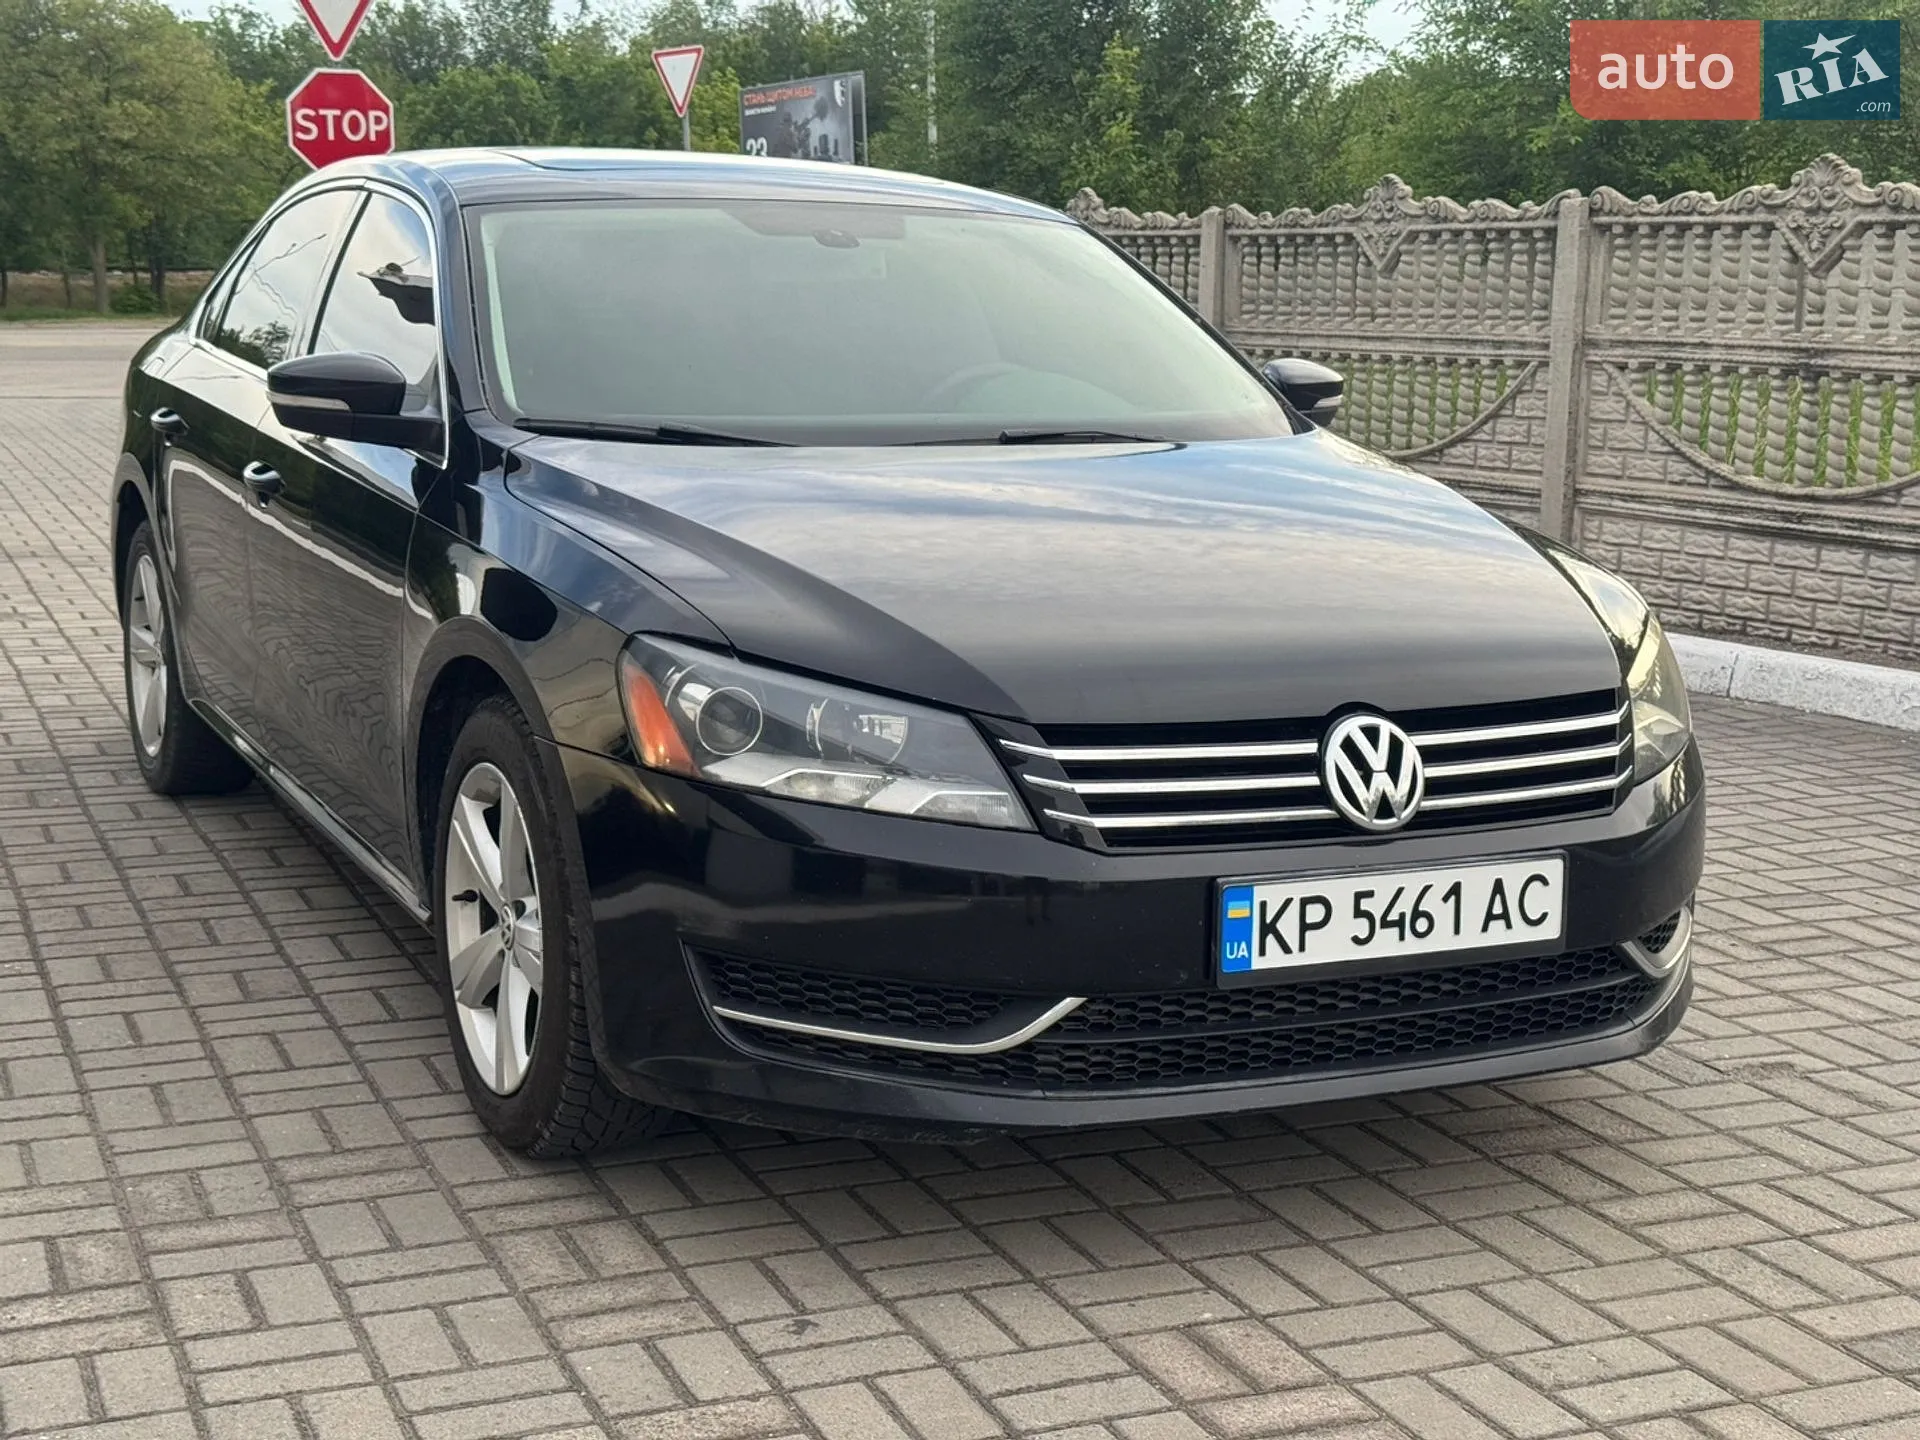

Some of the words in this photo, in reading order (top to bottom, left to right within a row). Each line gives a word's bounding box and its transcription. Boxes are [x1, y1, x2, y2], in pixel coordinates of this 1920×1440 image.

[295, 108, 389, 142] STOP
[1257, 894, 1333, 957] KP
[1350, 880, 1463, 946] 5461
[1480, 872, 1550, 934] AC
[1225, 942, 1249, 961] UA
